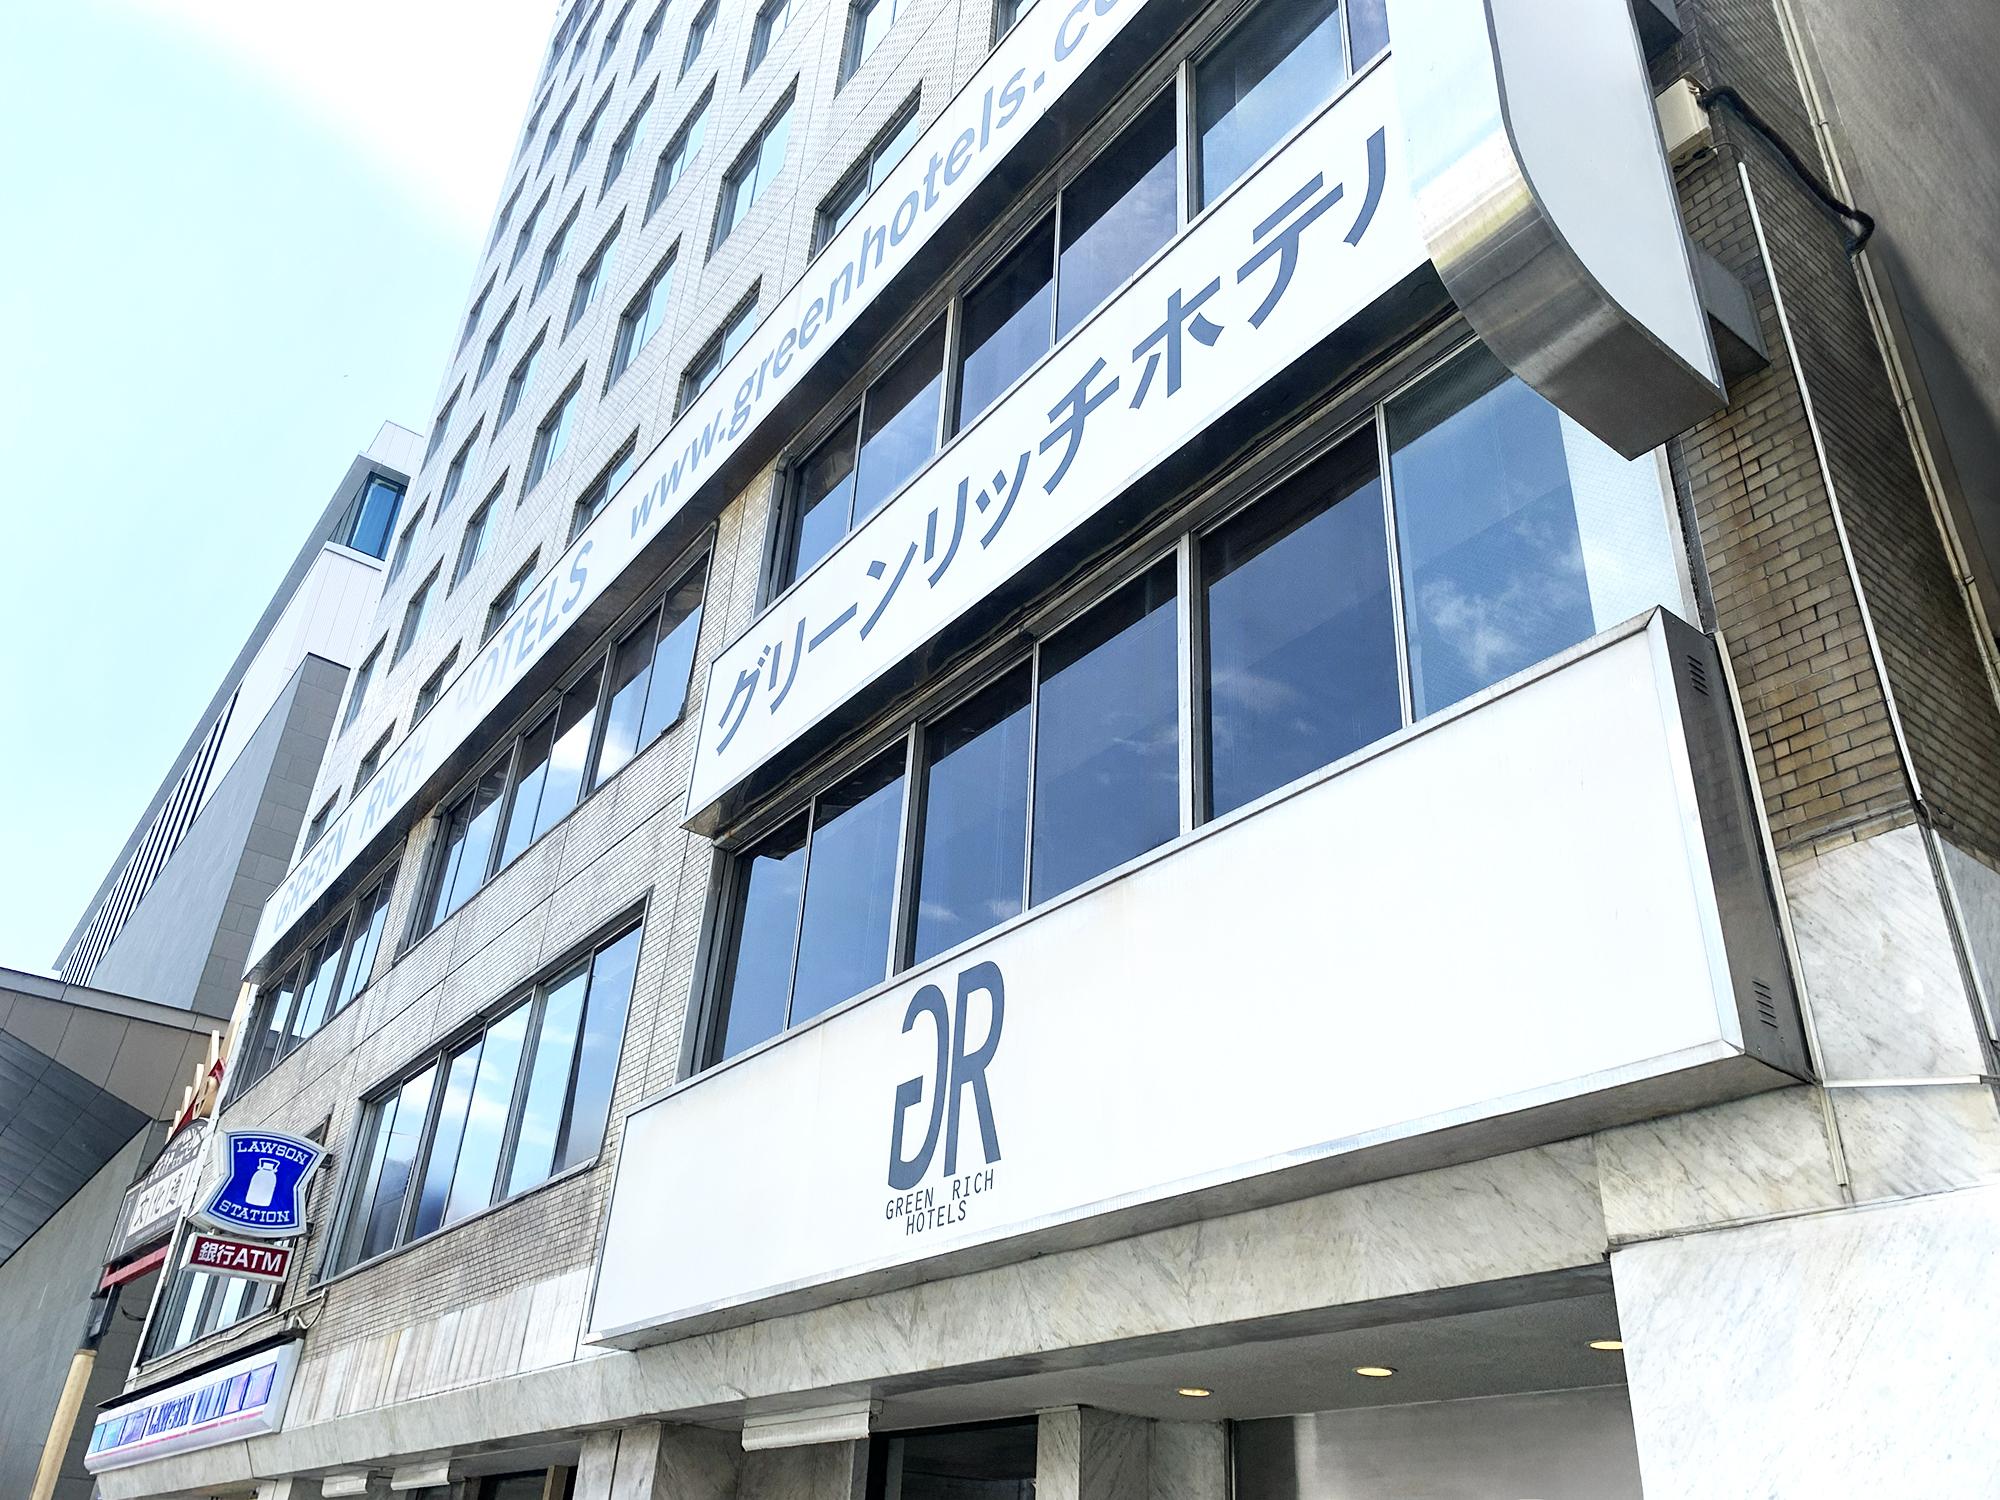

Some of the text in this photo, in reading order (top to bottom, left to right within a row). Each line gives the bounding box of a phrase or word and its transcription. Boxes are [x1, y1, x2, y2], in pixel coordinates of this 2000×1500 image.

[273, 814, 353, 934] GREEN
[359, 718, 433, 840] RICH
[630, 0, 1118, 539] www.greenhotels.c
[237, 1141, 309, 1165] LAWSON
[218, 1199, 290, 1223] STATION
[886, 1168, 994, 1220] GREEN RICH
[906, 1200, 967, 1236] HOTELS
[198, 1241, 283, 1272] 銀行ATM
[146, 1392, 196, 1436] LAWSON
